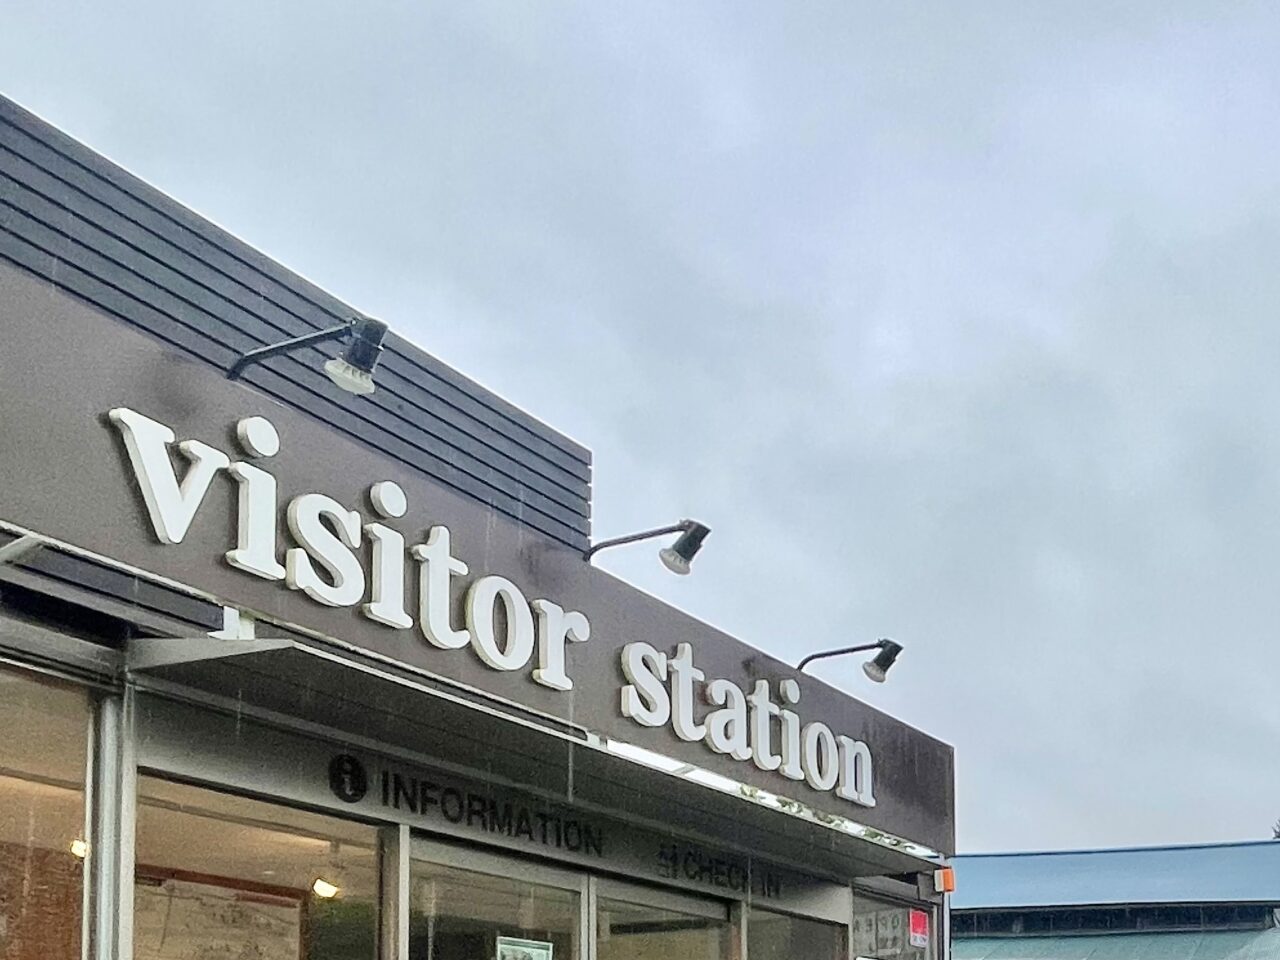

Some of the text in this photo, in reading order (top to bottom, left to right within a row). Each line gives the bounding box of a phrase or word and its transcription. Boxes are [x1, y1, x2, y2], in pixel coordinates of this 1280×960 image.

[109, 406, 877, 808] visitor station
[381, 769, 601, 857] INFORMATION
